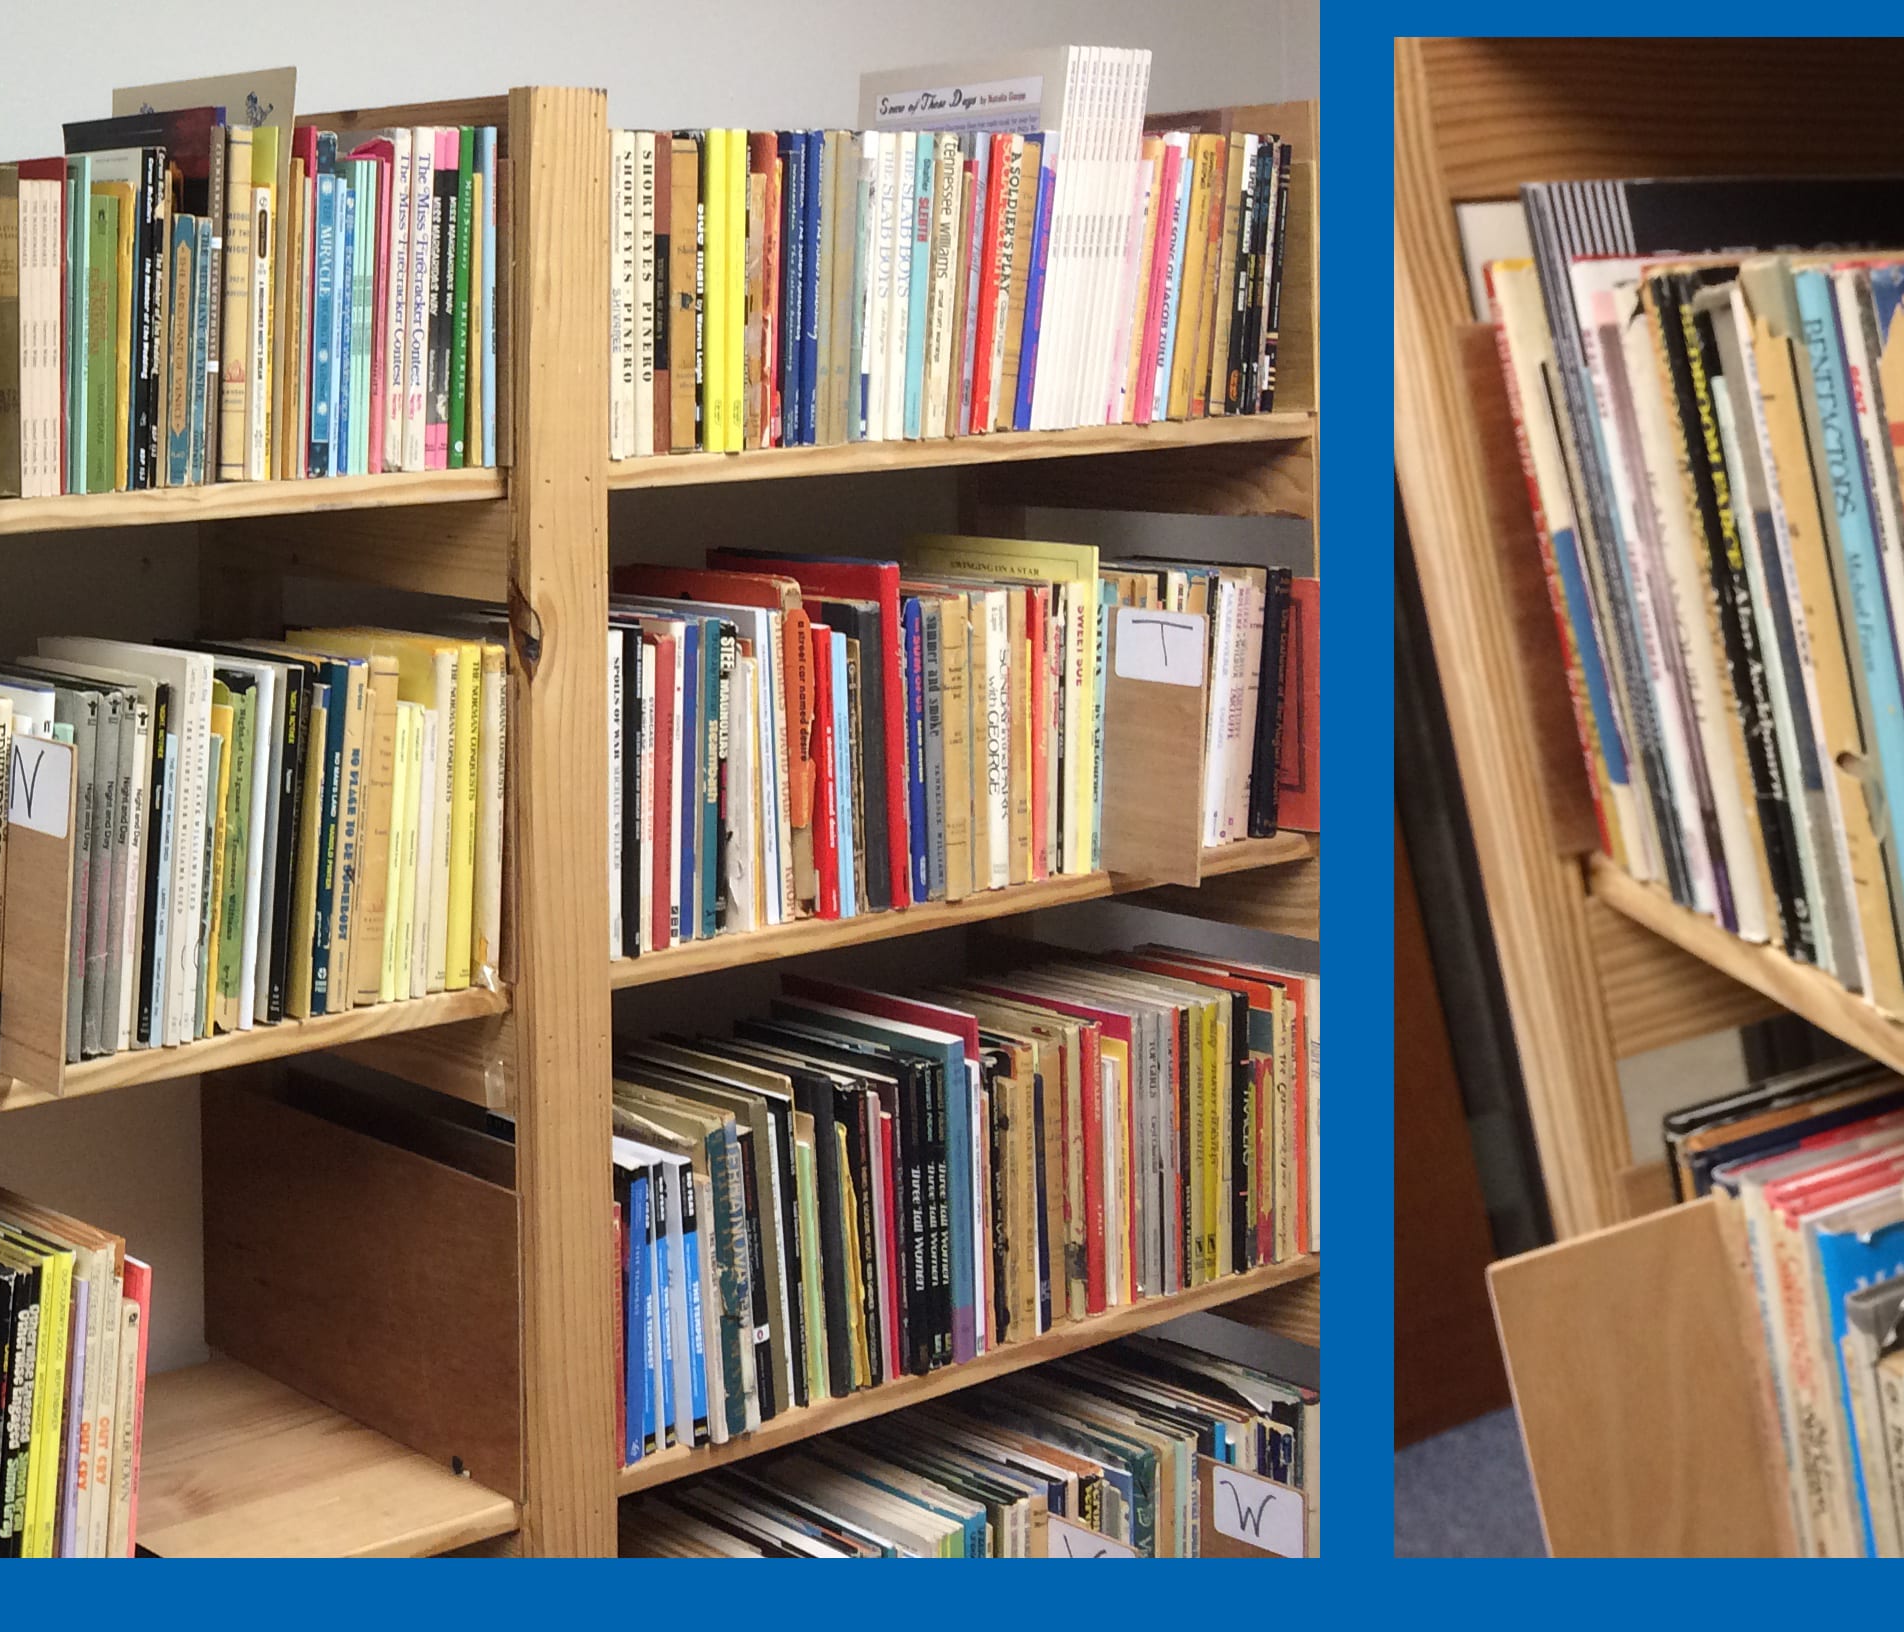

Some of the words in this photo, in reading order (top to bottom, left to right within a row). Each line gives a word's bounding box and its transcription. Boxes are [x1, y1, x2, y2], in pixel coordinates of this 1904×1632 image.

[623, 150, 634, 221] SHORT
[623, 230, 634, 282] EYES
[1131, 619, 1194, 666] T
[11, 744, 44, 818] N
[1220, 1481, 1276, 1536] W
